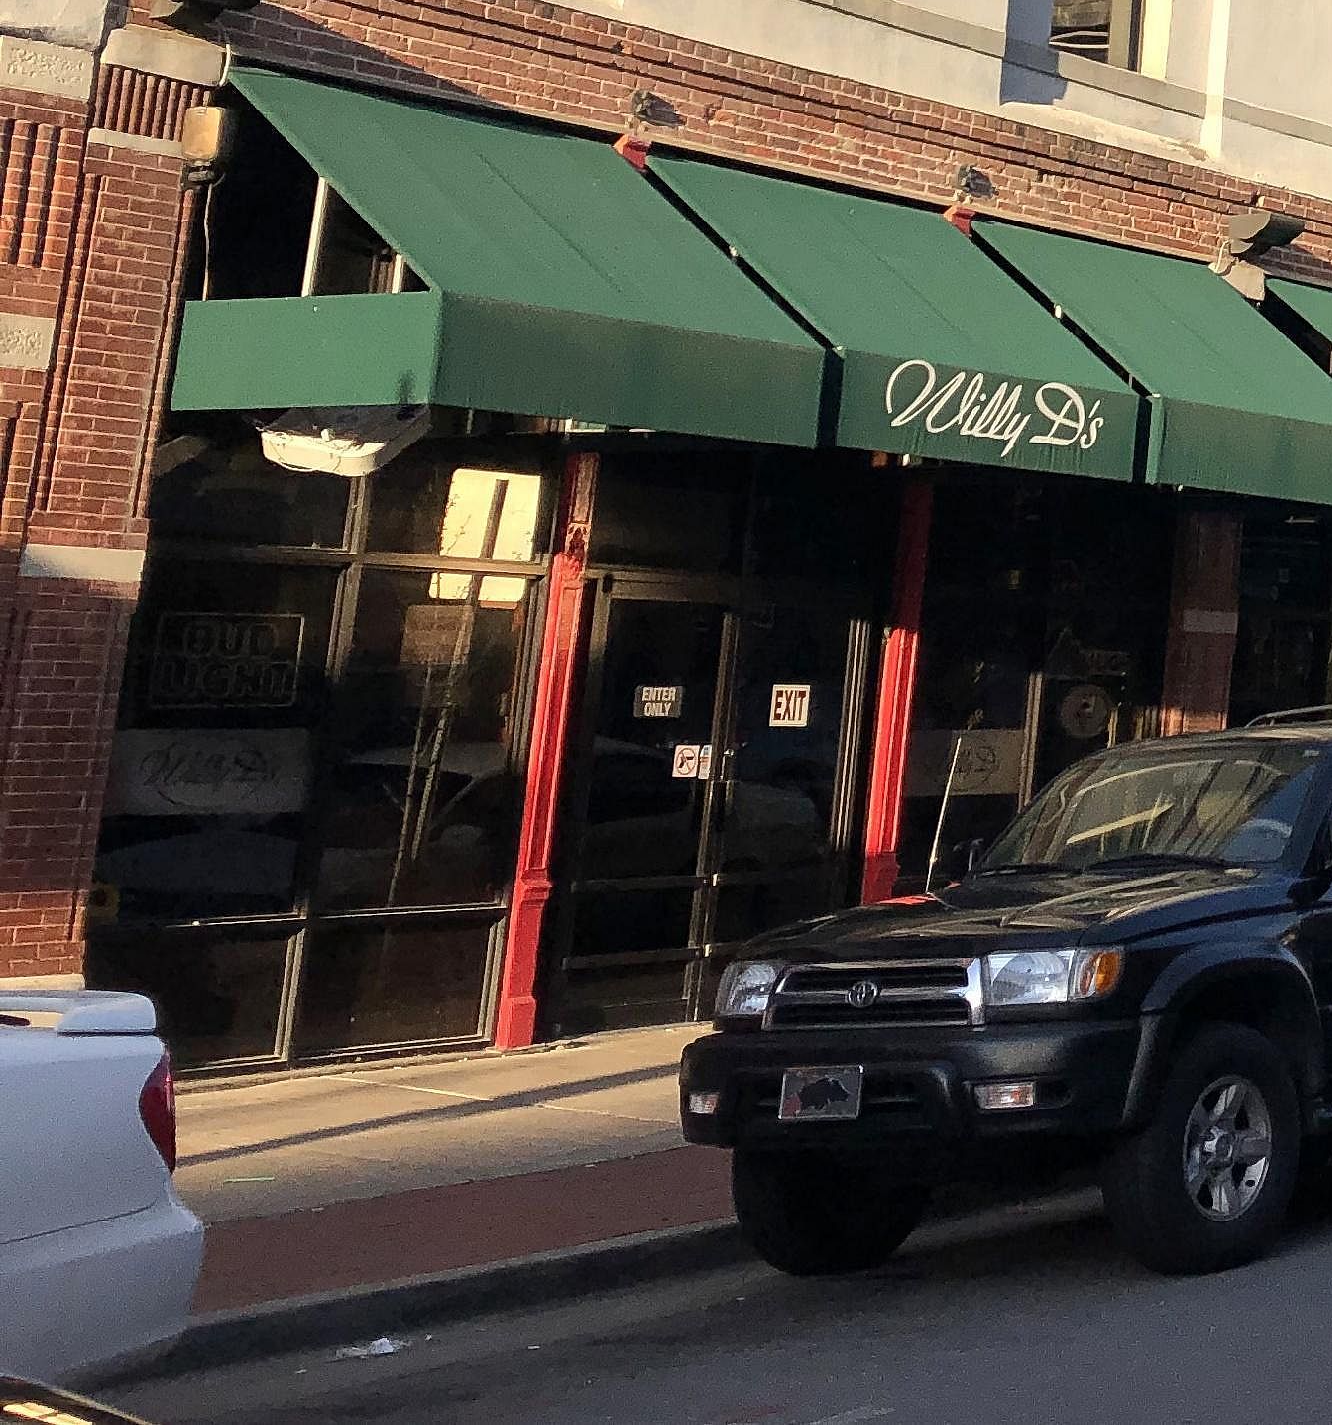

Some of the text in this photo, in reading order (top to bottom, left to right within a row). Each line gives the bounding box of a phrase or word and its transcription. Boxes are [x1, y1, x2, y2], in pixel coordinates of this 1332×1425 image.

[885, 359, 1104, 457] Willy D's
[641, 686, 676, 702] ENTER
[773, 690, 807, 721] EXIT
[643, 702, 672, 717] ONLY
